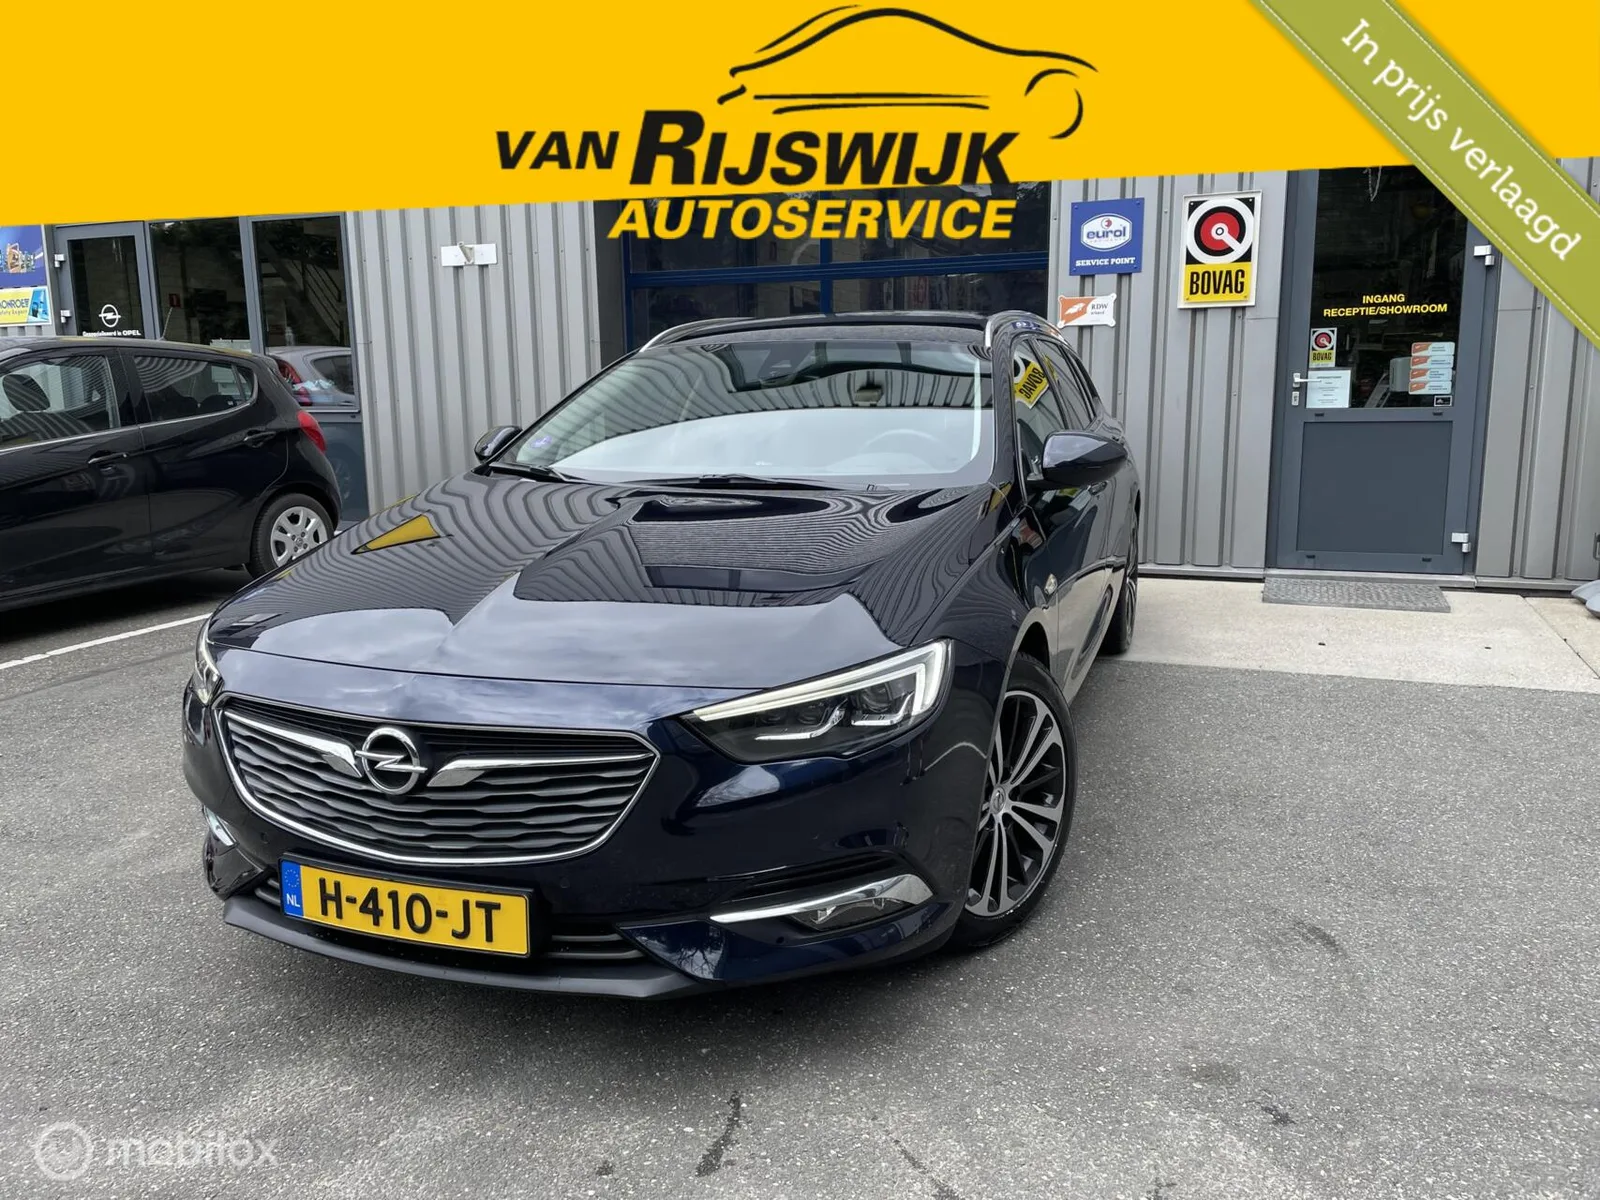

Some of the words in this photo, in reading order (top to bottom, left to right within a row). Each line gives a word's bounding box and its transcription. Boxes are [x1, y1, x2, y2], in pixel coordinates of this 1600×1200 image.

[1086, 226, 1126, 240] eurol
[1075, 259, 1110, 267] SERVICE
[1110, 257, 1135, 266] POINT
[1189, 269, 1246, 296] BOVAG
[1362, 294, 1405, 303] INGANG
[1323, 304, 1447, 317] RECEPTIE/SHOWROOM
[1312, 352, 1332, 361] BOVAG
[286, 894, 301, 908] NL
[318, 877, 502, 944] H-410-JT
